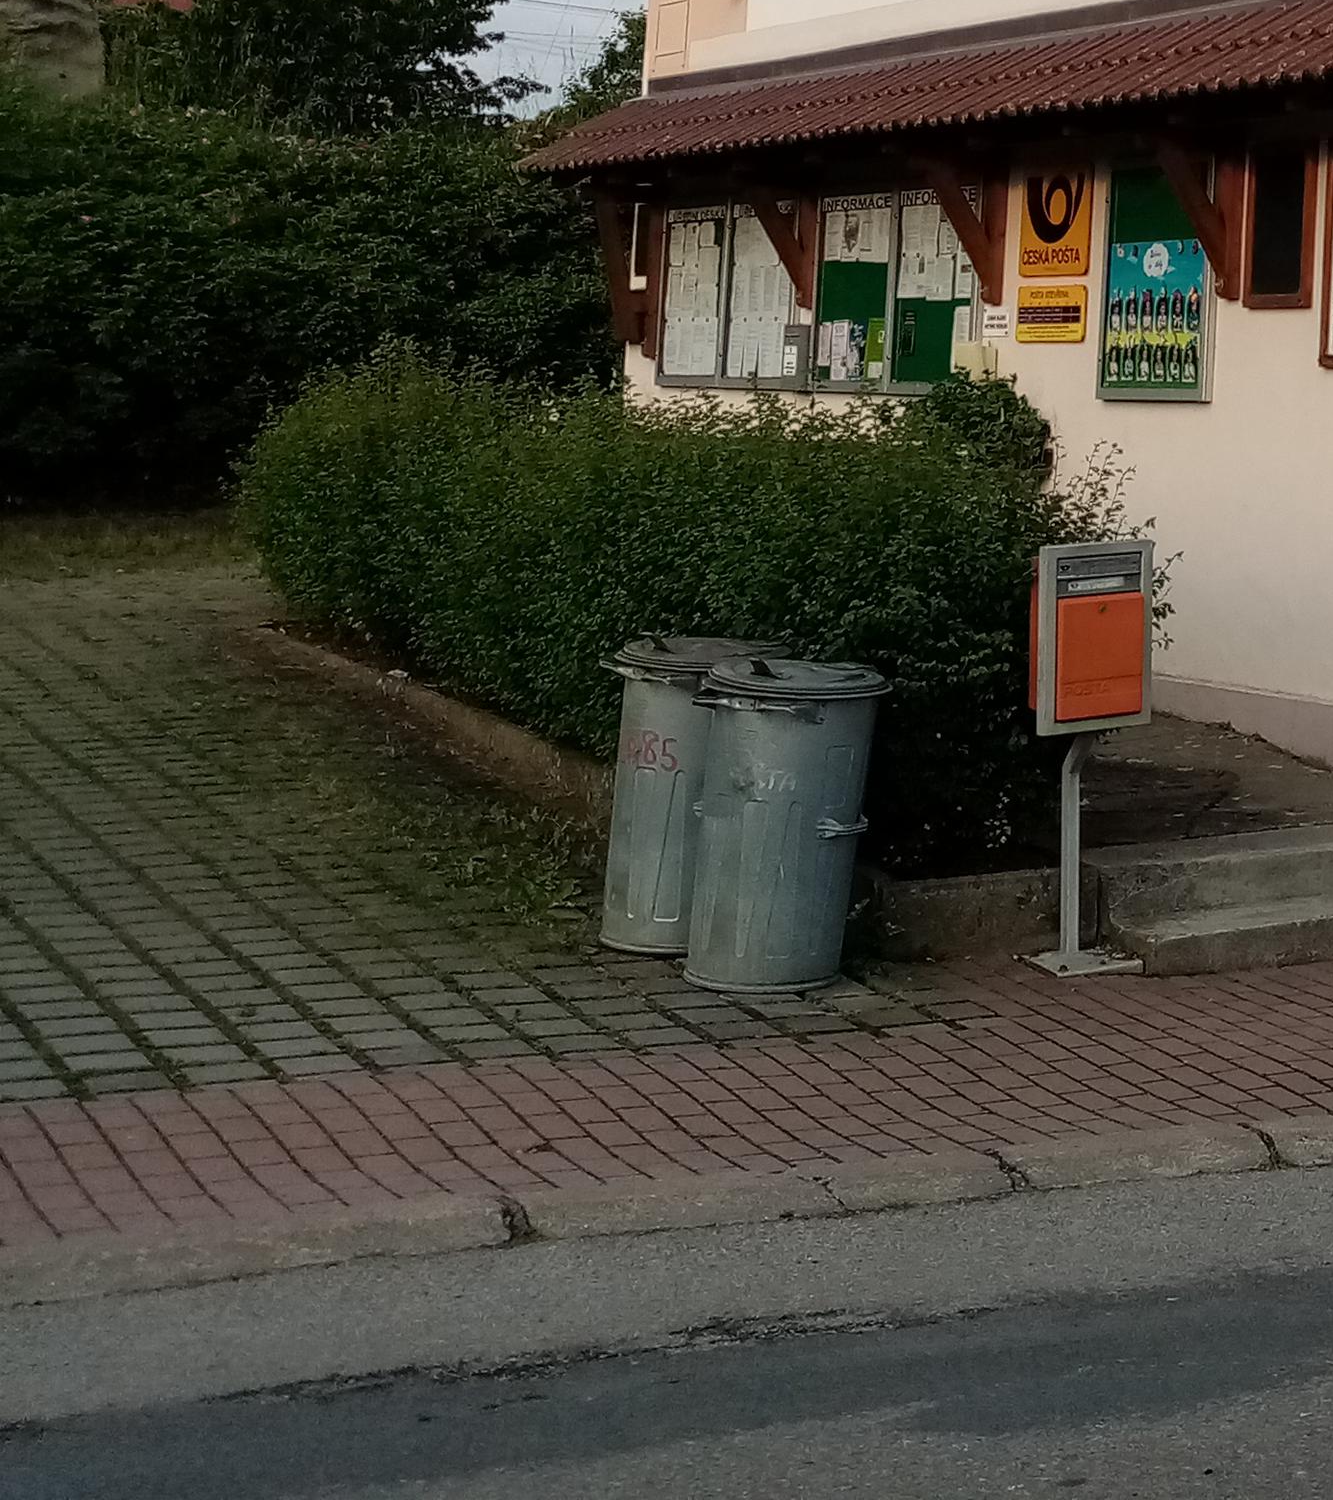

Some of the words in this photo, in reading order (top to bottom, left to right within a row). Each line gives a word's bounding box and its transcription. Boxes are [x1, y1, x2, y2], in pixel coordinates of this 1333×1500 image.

[822, 195, 892, 212] INFORMACE
[1022, 246, 1049, 266] ČESKÁ
[1051, 244, 1081, 264] POŠTA
